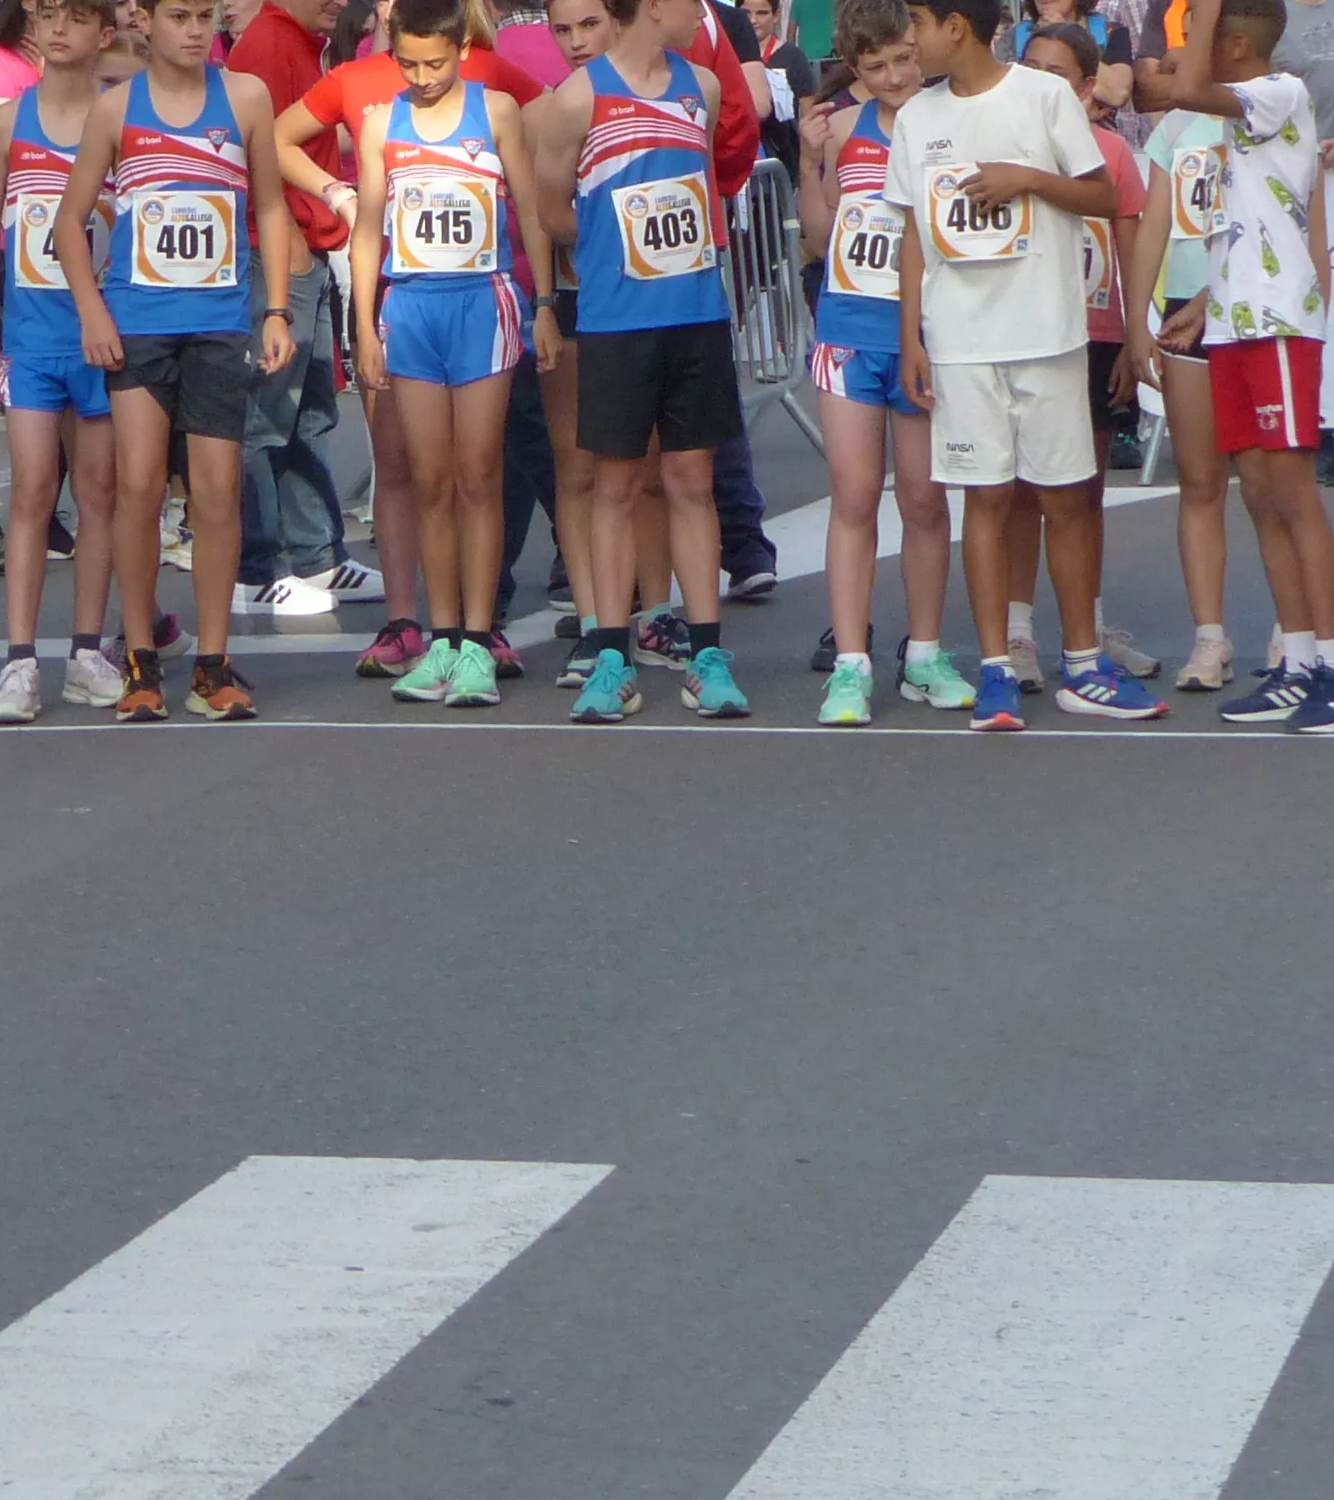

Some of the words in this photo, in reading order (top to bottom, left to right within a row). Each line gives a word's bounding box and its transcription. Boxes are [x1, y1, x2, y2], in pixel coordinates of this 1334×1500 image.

[926, 138, 953, 150] NASA
[157, 224, 214, 260] 401
[415, 210, 473, 245] 415
[643, 208, 698, 251] 403
[946, 442, 975, 453] NASA
